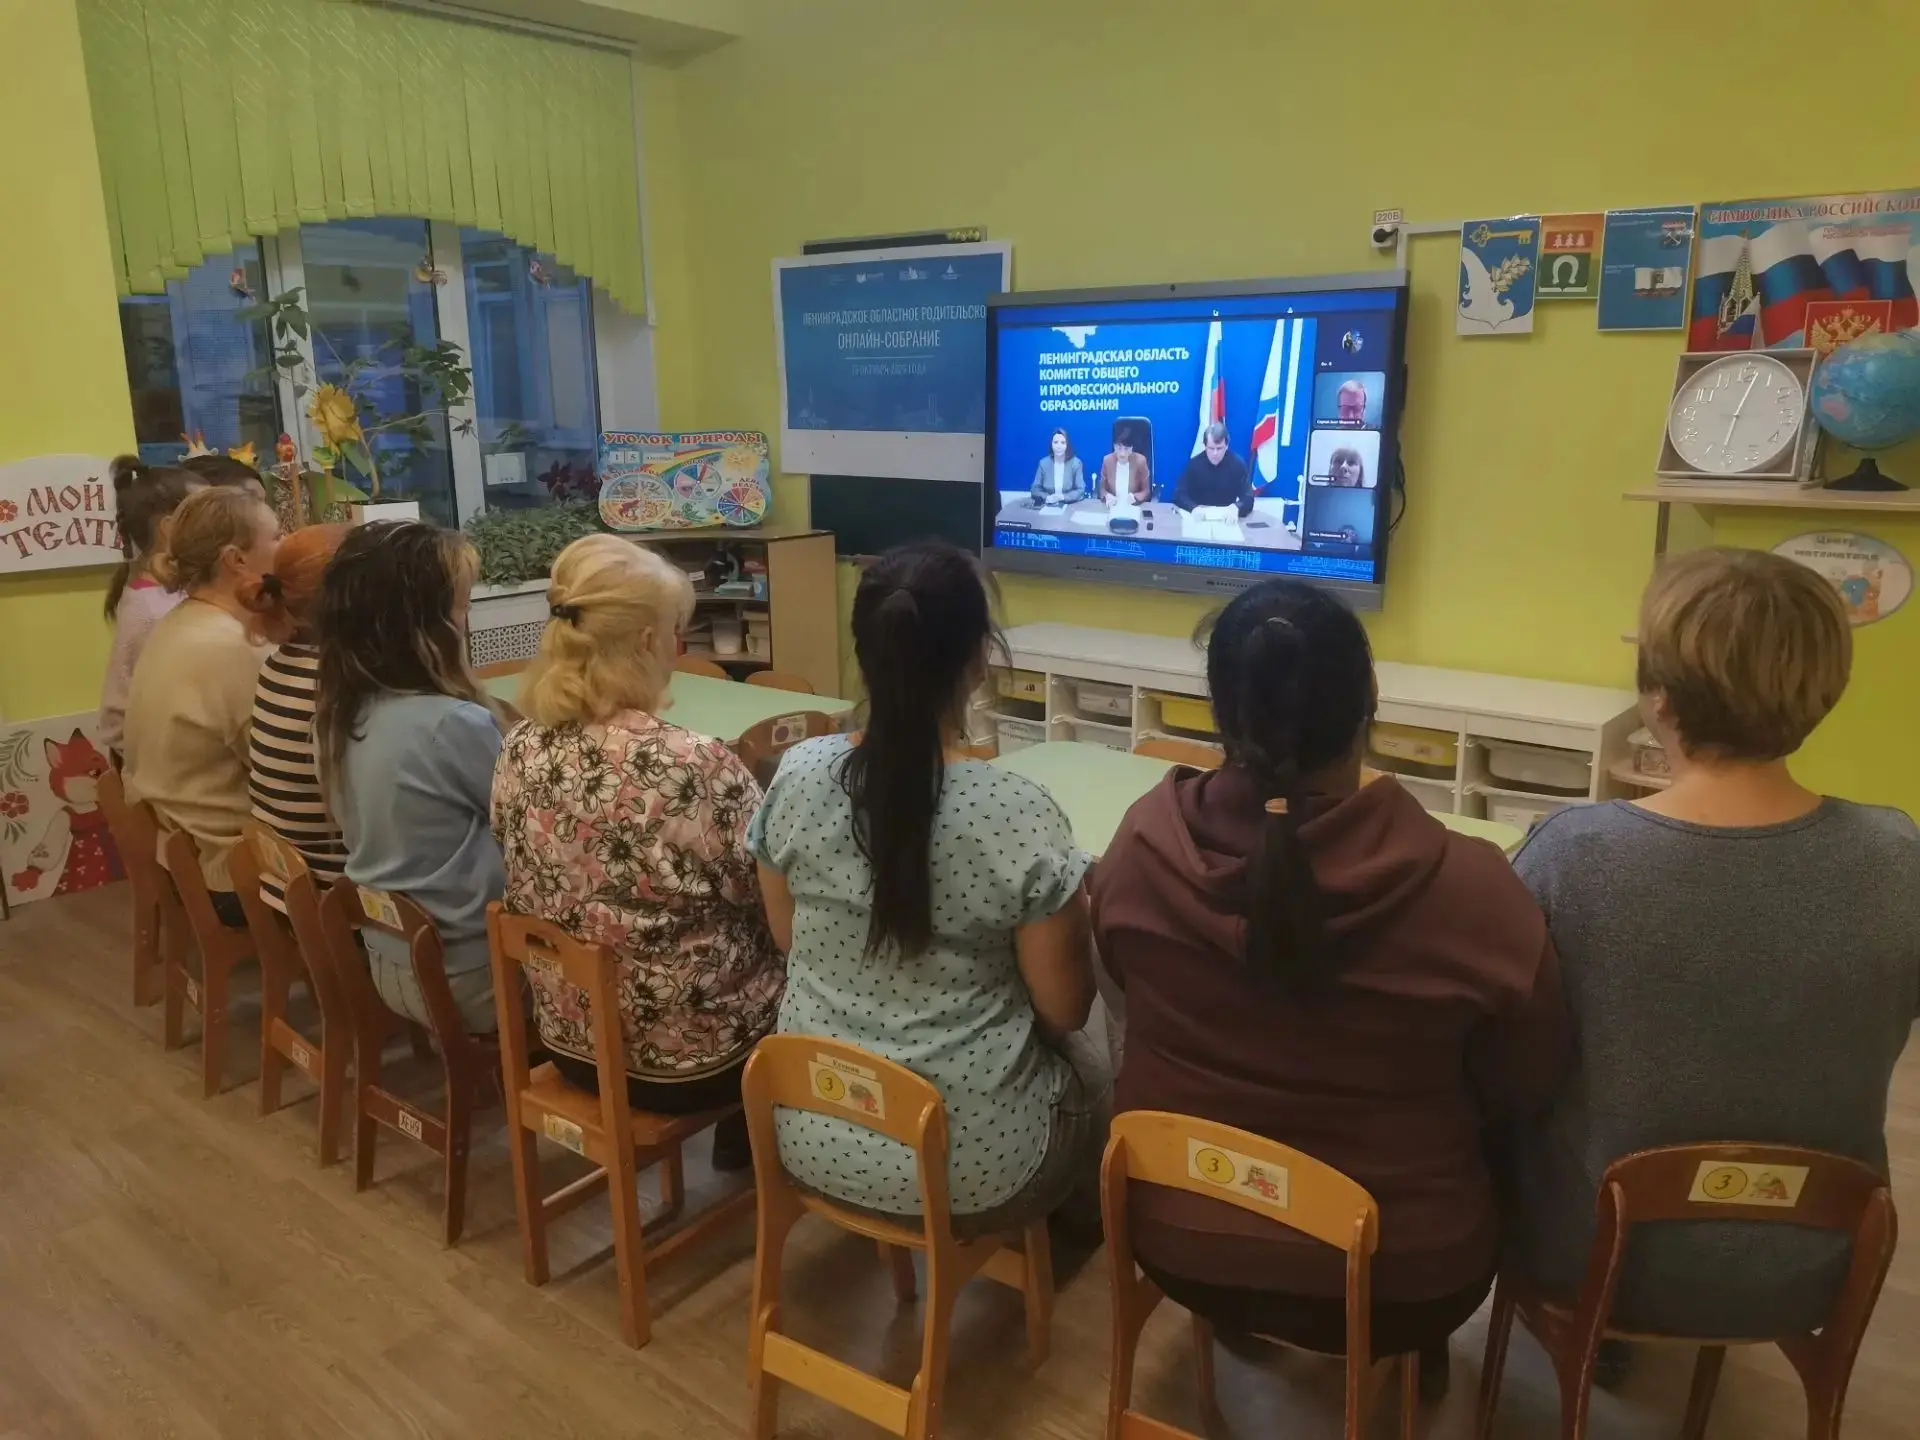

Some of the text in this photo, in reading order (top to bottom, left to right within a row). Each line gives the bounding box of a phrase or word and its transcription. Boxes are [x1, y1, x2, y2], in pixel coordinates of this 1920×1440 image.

[803, 304, 986, 326] ЛЕНИНГРАДСКОЕ ОБЛАСТНОЕ РОДИТЕЛЬСКО
[838, 328, 941, 349] ОНЛАЙН-СОБРАНИЕ
[1039, 347, 1189, 365] ЛЕНИНГРАДСКАЯ ОБЛАСТЬ
[1039, 366, 1139, 380] КОМИТЕТ ОБЩЕГО
[1040, 381, 1179, 396] И ПРОФЕССИОНАЛЬНОГО
[1040, 399, 1119, 411] ОБРАЗОВАНИЯ
[604, 432, 762, 445] УГОЛОК ПРИРОДЫ
[27, 476, 105, 516] МОЙ
[825, 1077, 834, 1092] 3
[1208, 1158, 1219, 1172] 3
[1714, 1174, 1732, 1190] 3
